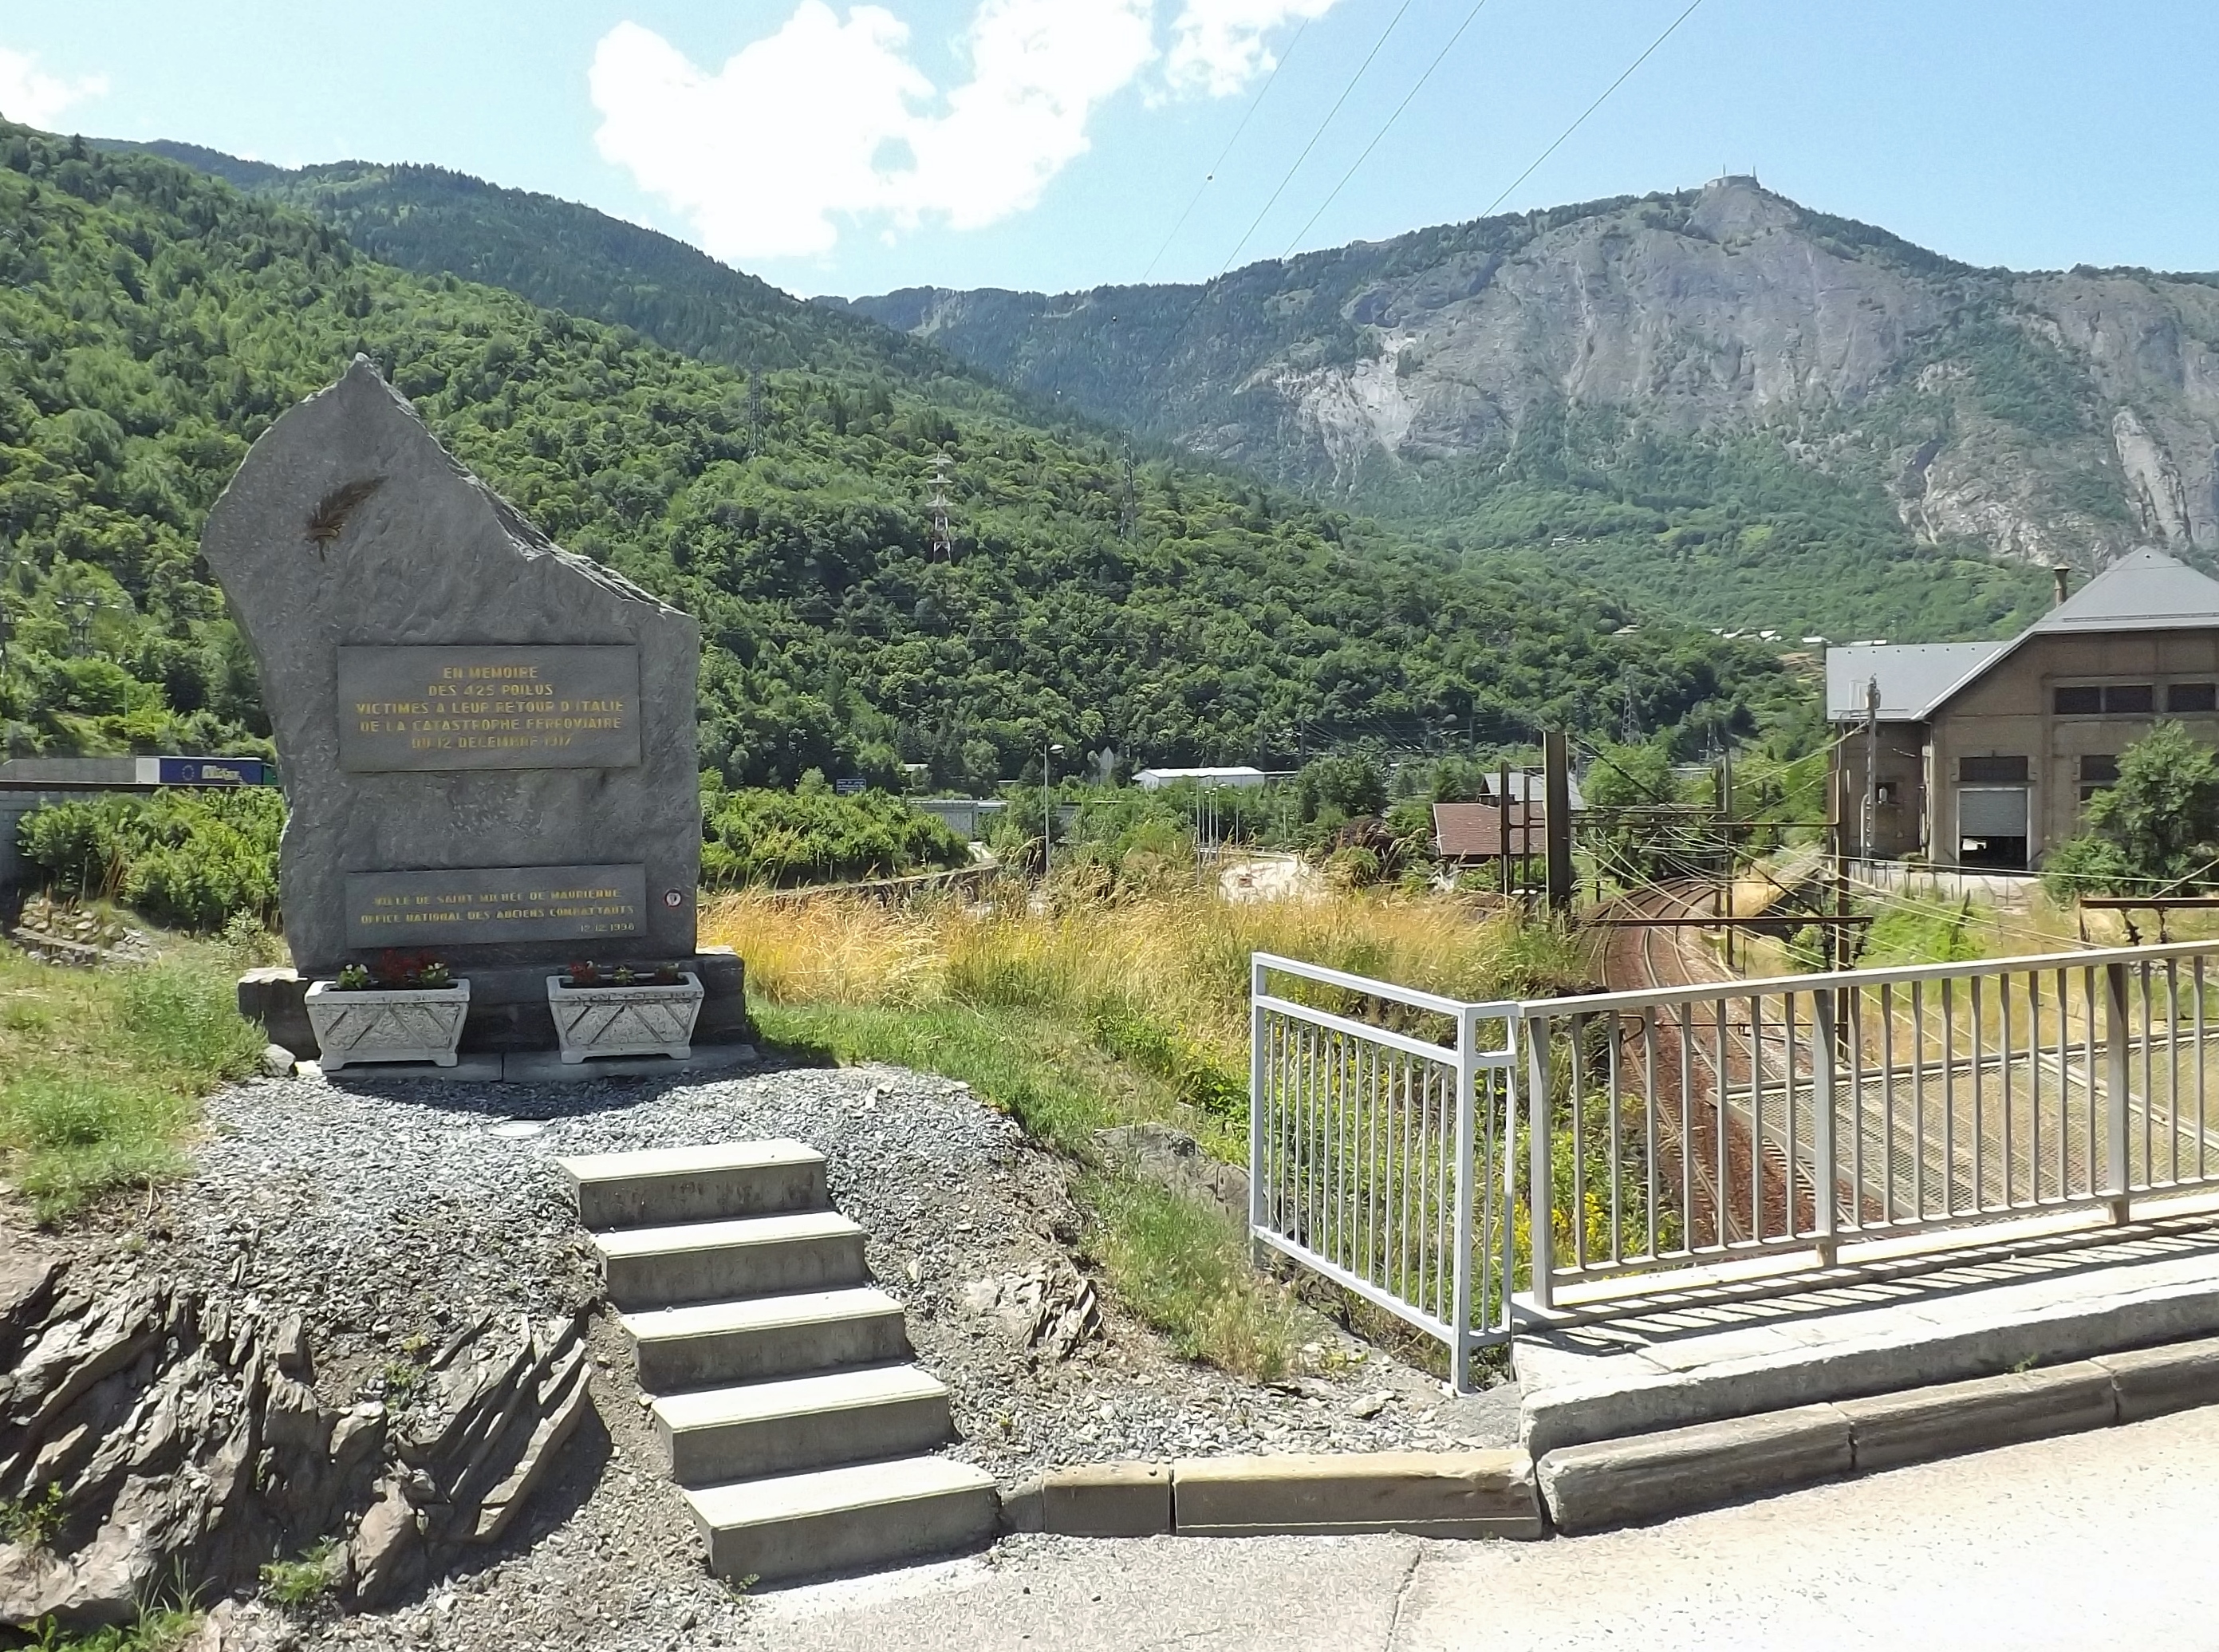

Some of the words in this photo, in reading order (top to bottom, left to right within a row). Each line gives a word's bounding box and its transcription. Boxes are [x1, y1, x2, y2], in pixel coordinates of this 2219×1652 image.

[443, 667, 463, 679] EN
[469, 666, 538, 679] MEMOIRE
[428, 684, 456, 696] DES
[463, 684, 495, 696] 425
[502, 684, 554, 696] POILUS
[357, 702, 428, 715] VICTIMES
[436, 703, 444, 713] A
[452, 702, 489, 714] LEUR
[496, 700, 554, 713] RETOUR
[360, 720, 379, 731] DE
[385, 720, 405, 731] LA
[412, 719, 519, 731] CATASTROPHE
[526, 716, 621, 730] FERROVIAIRE
[416, 895, 431, 905] DE
[437, 893, 474, 905] SAINT
[530, 890, 545, 901] DE
[550, 888, 621, 900] MAURIENNE
[361, 913, 401, 925] OFFICE
[406, 911, 463, 923] NATIONAL
[467, 910, 490, 921] DES
[496, 907, 545, 919] ANCIENS
[550, 905, 635, 917] COMBATTANTS
